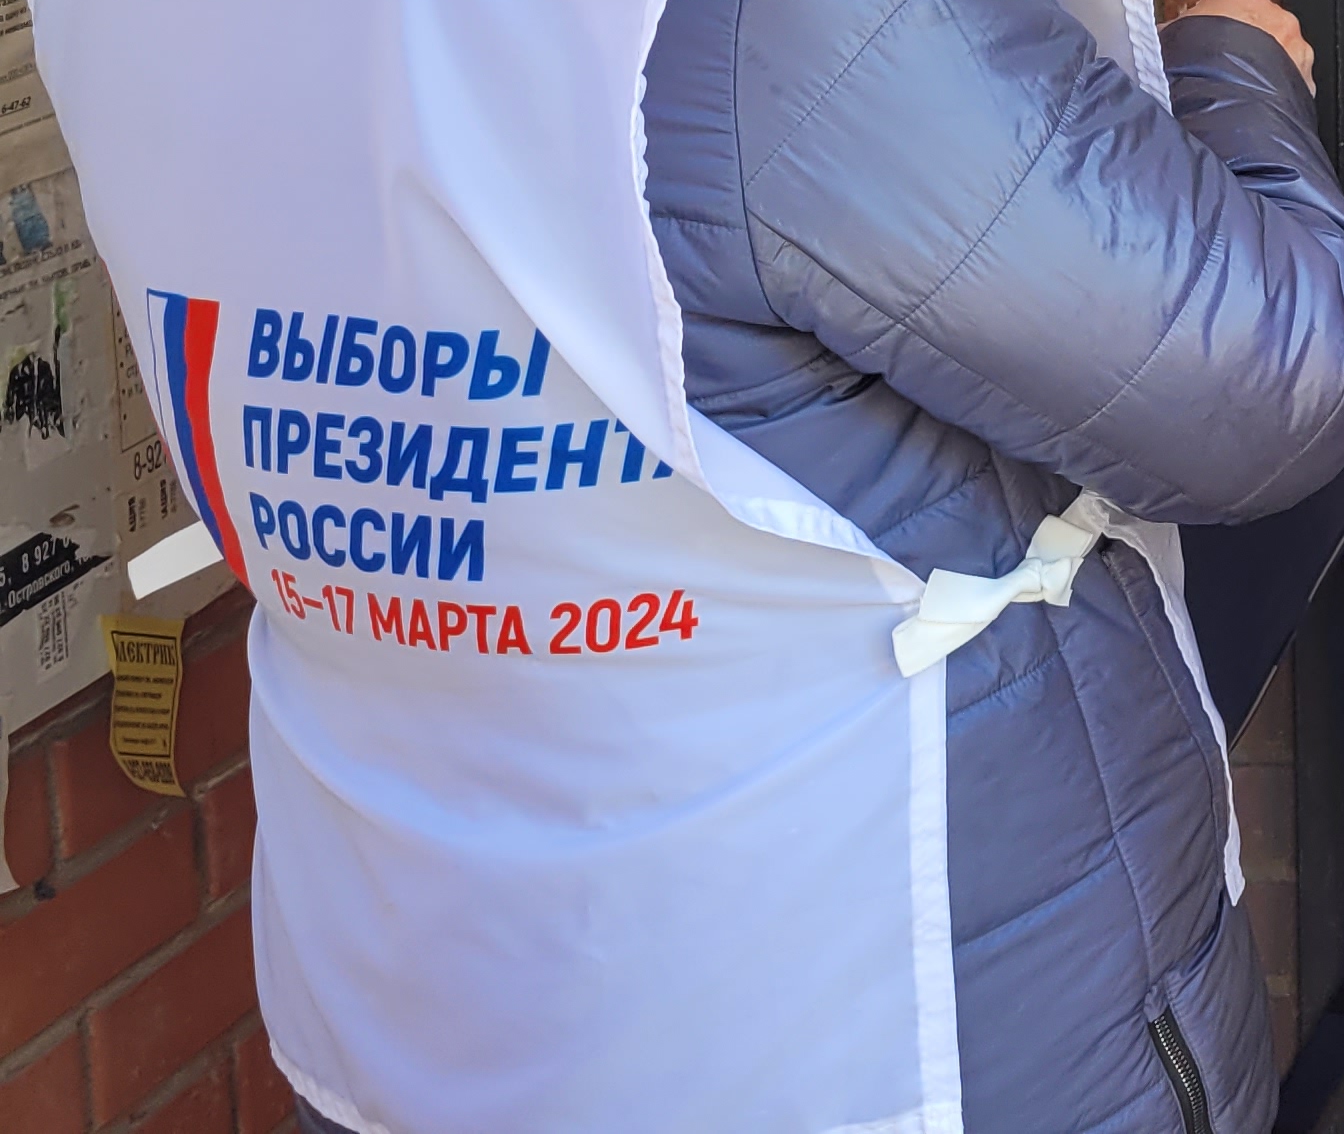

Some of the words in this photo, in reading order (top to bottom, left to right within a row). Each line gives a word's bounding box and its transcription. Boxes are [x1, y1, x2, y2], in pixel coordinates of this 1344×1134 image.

[247, 308, 551, 401] ВЫБОРЫ
[242, 404, 675, 503] ПРЕЗИДЕНТ
[248, 492, 486, 582] РОССИИ
[117, 641, 176, 666] ЛЕКТРИК
[367, 591, 533, 656] МАРТА
[549, 589, 700, 656] 2024
